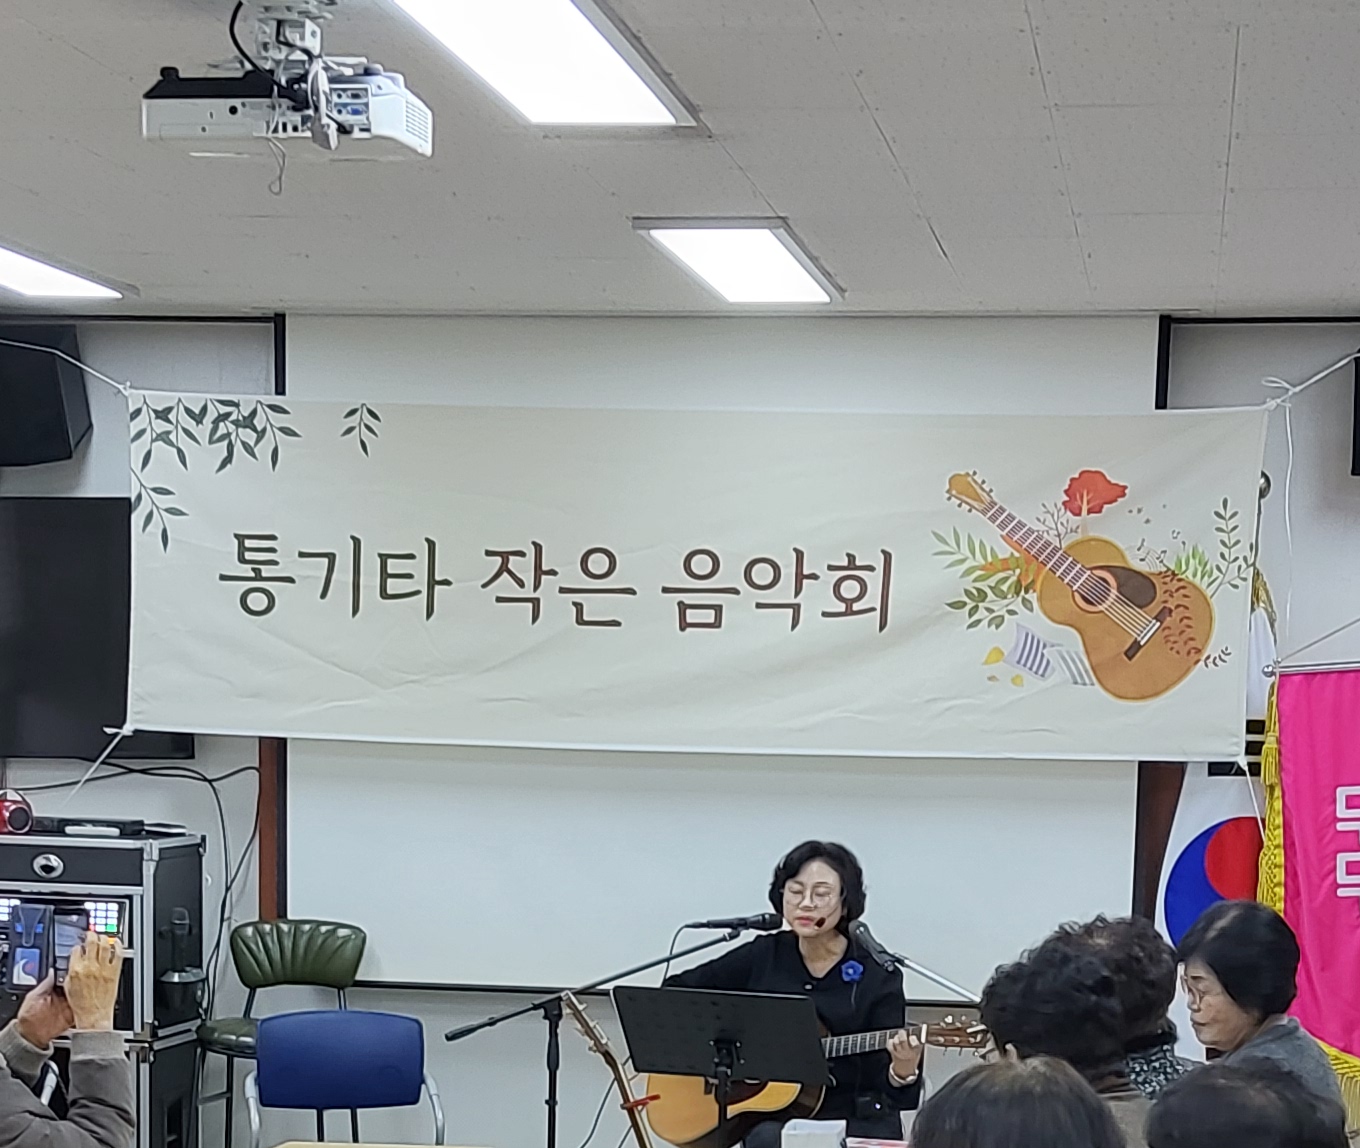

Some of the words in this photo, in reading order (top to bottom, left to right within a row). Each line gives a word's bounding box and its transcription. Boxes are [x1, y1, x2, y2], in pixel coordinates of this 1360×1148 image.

[218, 532, 453, 622] 통기타
[480, 540, 638, 629] 작은
[661, 546, 892, 633] 음악회
